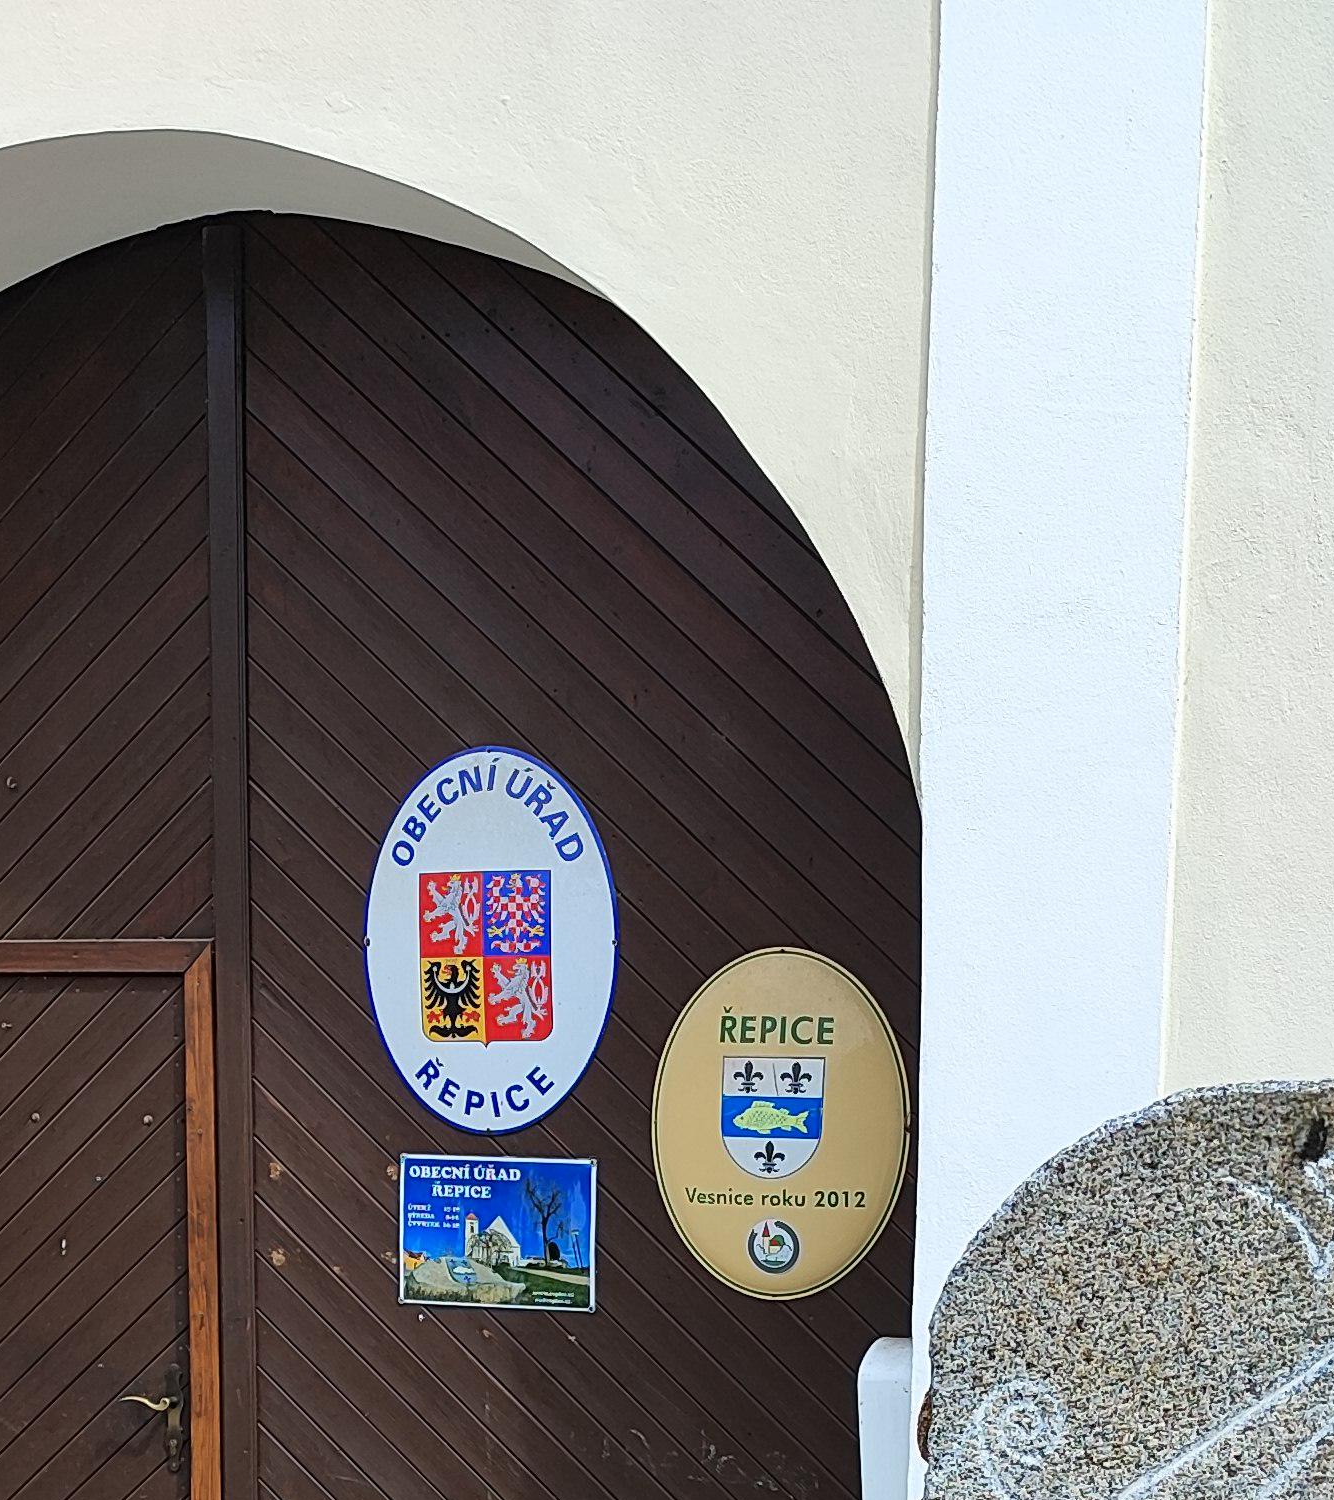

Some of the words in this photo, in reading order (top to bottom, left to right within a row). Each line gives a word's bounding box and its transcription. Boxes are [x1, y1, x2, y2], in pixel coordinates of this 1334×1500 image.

[392, 757, 501, 866] OBECNÍ
[505, 767, 584, 862] ÚŘAD
[719, 1006, 835, 1045] ŘEPICE
[415, 1057, 555, 1117] ŘEPICE
[408, 1164, 470, 1179] OBECNÍ
[473, 1164, 522, 1181] ÚŘAD
[431, 1181, 492, 1198] ŘEPICE
[685, 1187, 754, 1206] Vesnice
[761, 1189, 806, 1208] roku
[814, 1190, 866, 1208] 2012
